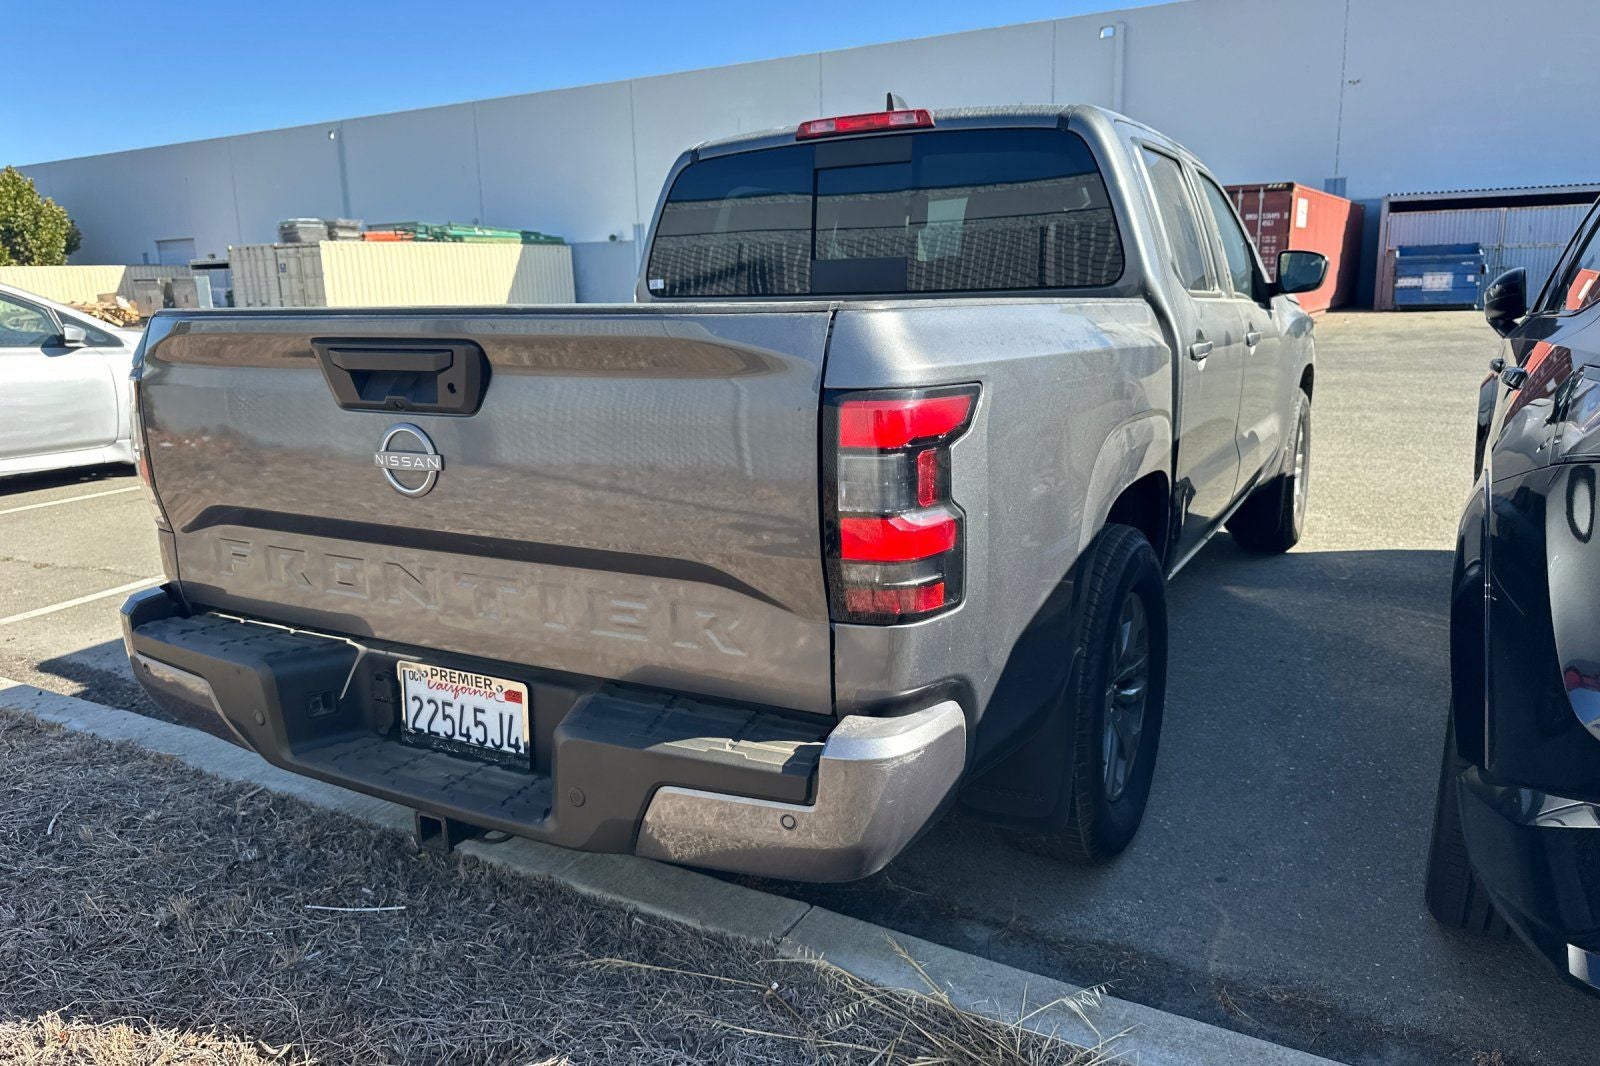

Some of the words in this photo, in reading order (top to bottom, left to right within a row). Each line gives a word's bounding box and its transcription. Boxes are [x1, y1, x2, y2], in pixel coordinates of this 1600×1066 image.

[375, 454, 439, 469] NISSAN
[213, 537, 748, 657] FRONTIER
[430, 667, 493, 691] PREMIER
[411, 695, 522, 753] 22545J4
